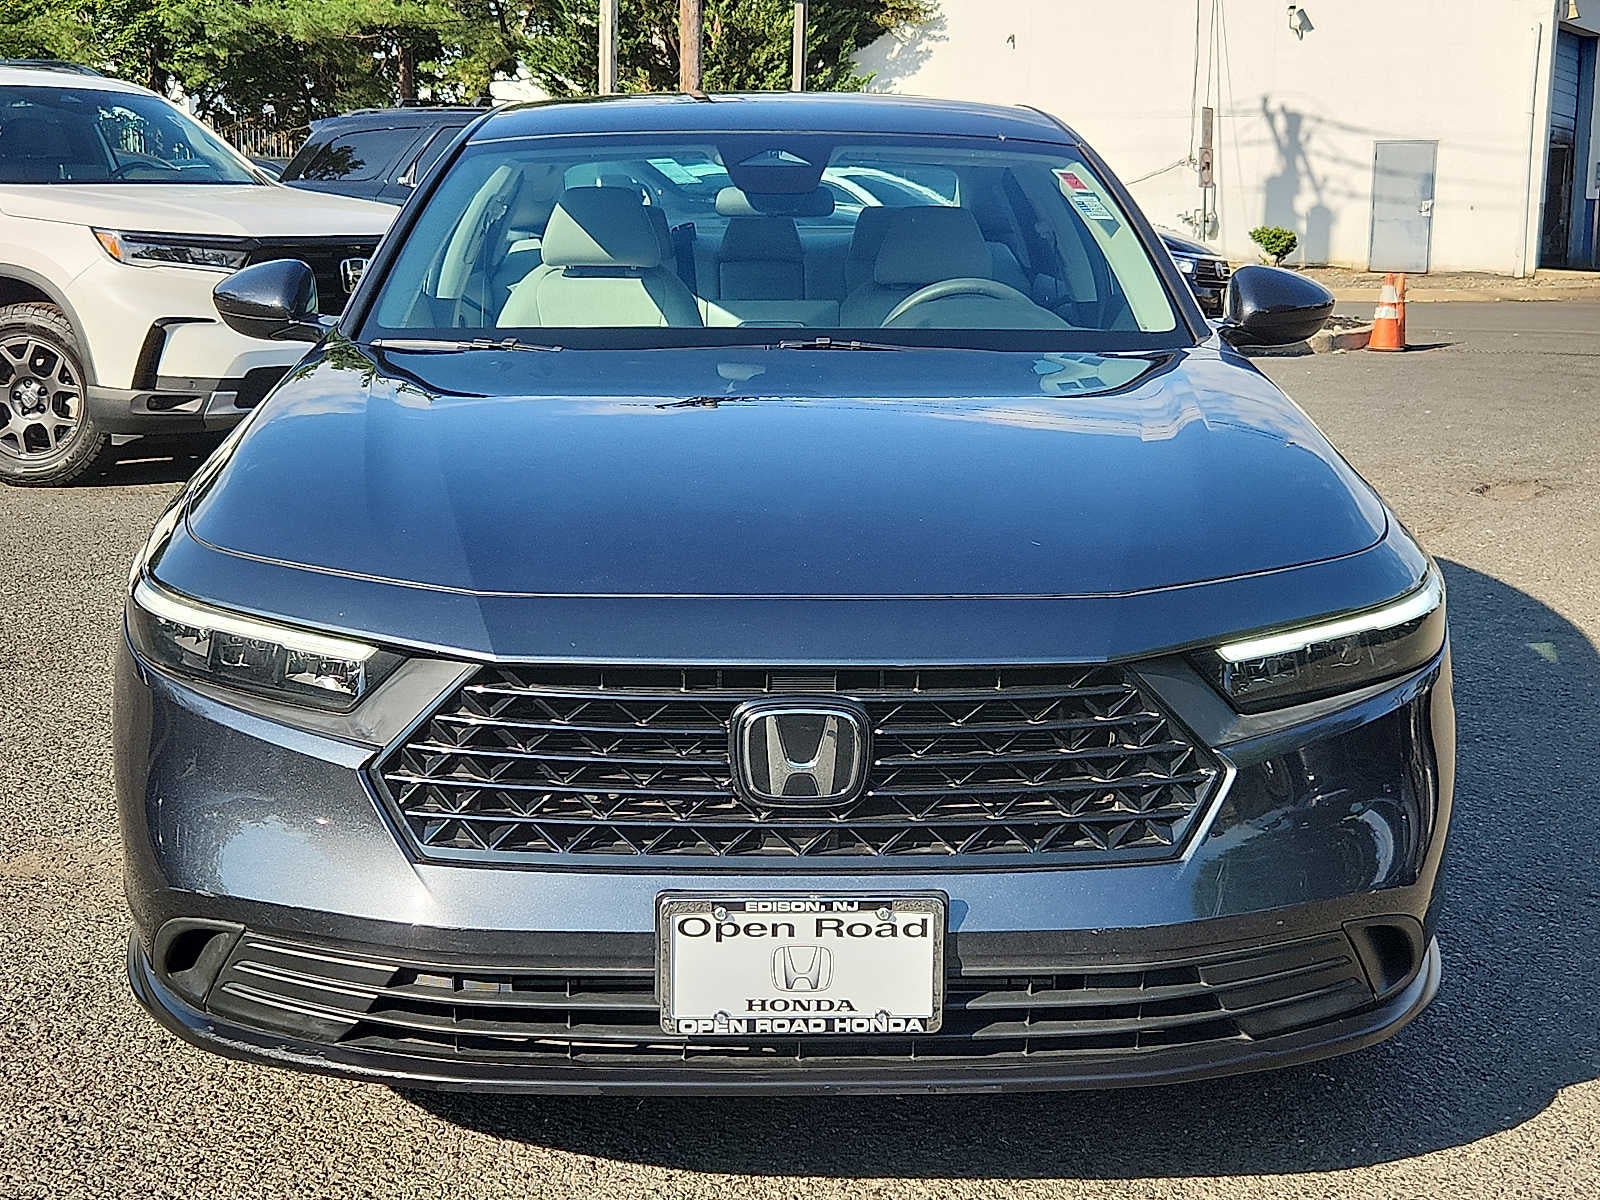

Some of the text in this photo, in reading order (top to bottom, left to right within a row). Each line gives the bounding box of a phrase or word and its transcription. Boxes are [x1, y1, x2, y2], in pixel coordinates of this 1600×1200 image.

[745, 901, 859, 912] EDISON, NJ
[677, 917, 928, 942] Open Road
[745, 999, 858, 1012] HONDA
[678, 1019, 924, 1034] OPEN ROAD HONDA
